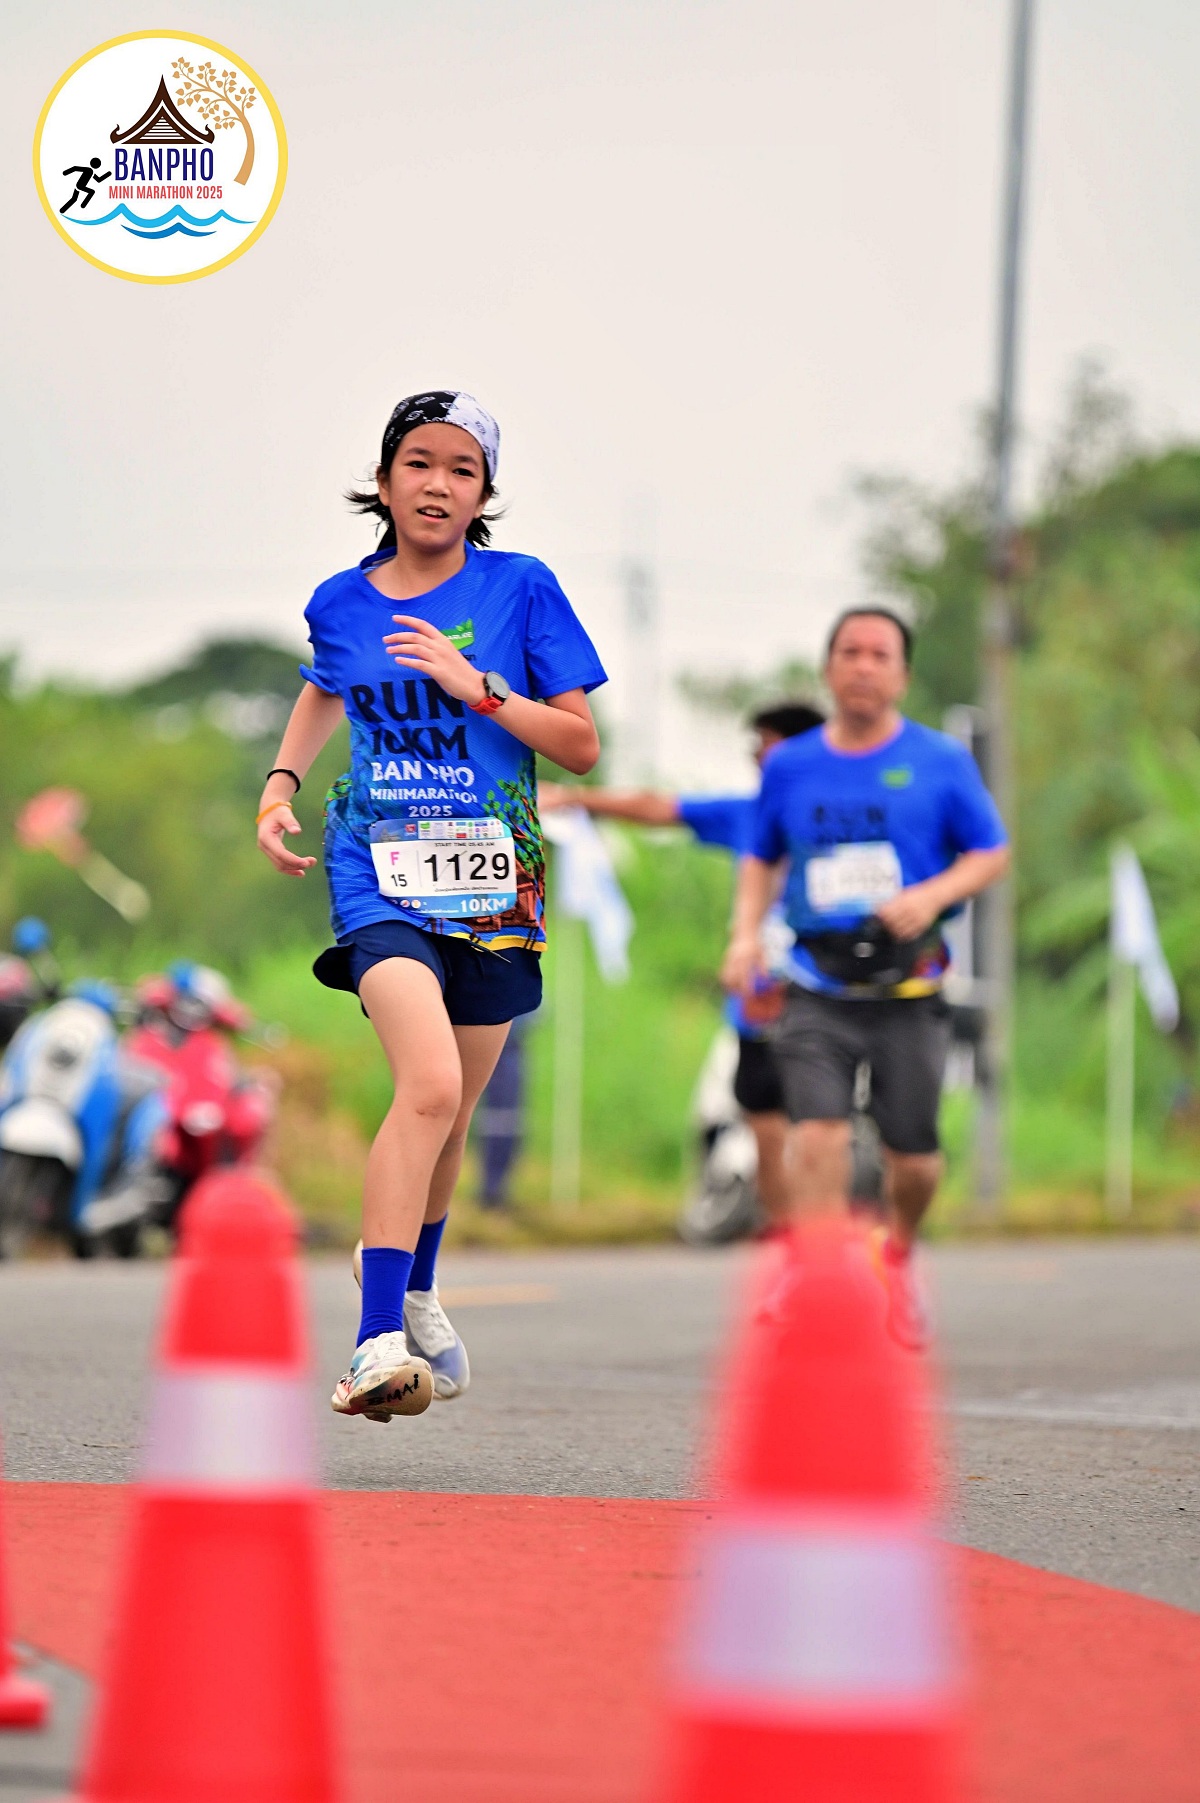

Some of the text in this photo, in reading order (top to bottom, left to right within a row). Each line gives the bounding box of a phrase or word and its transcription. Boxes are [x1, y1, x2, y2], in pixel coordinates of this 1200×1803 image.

[350, 678, 465, 723] RUN
[370, 725, 469, 760] 10KM
[371, 760, 422, 781] BAN
[408, 805, 453, 818] 2025
[390, 851, 400, 866] F
[424, 852, 510, 882] 1129
[391, 873, 408, 887] 15
[460, 898, 508, 913] 10KM
